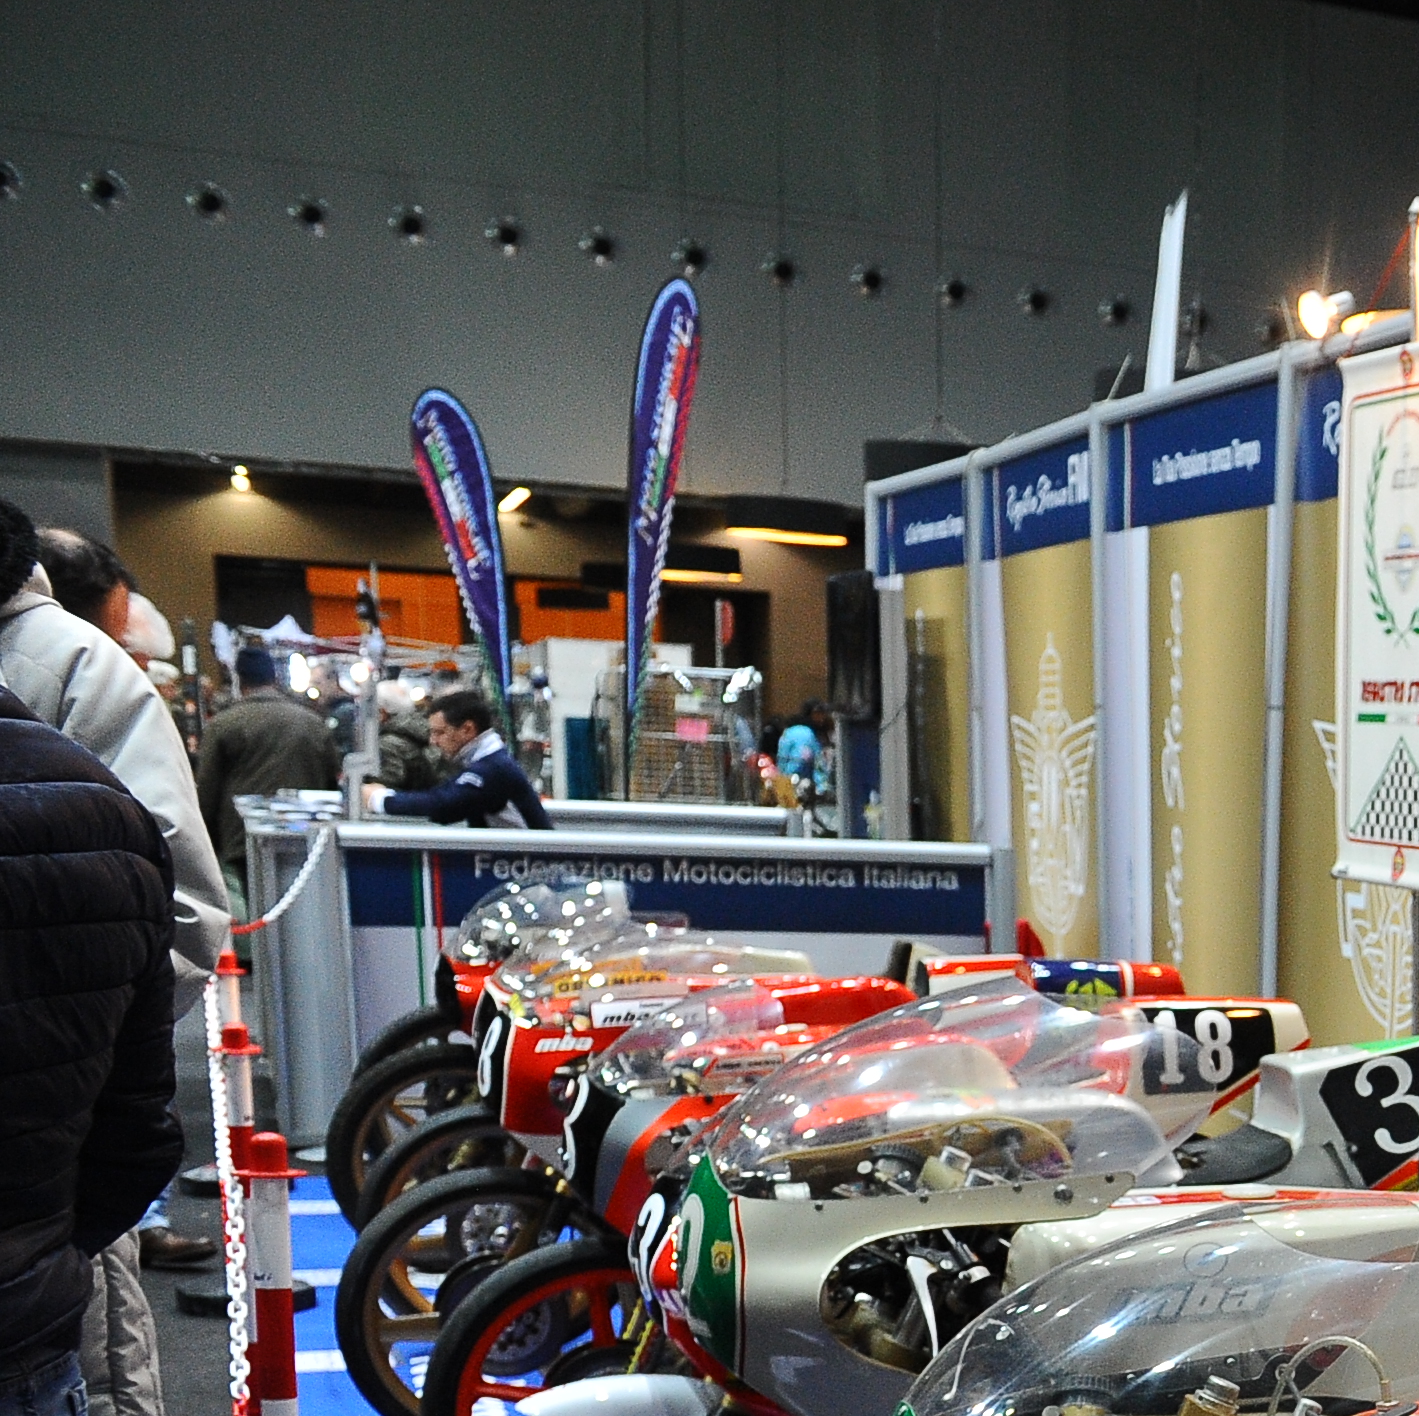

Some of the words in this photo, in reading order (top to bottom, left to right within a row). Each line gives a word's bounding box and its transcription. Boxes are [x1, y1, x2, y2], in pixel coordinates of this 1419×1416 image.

[475, 854, 653, 887] Federazione
[663, 858, 857, 889] Motociclistica
[863, 865, 960, 891] Italiana
[1153, 1009, 1234, 1085] 18
